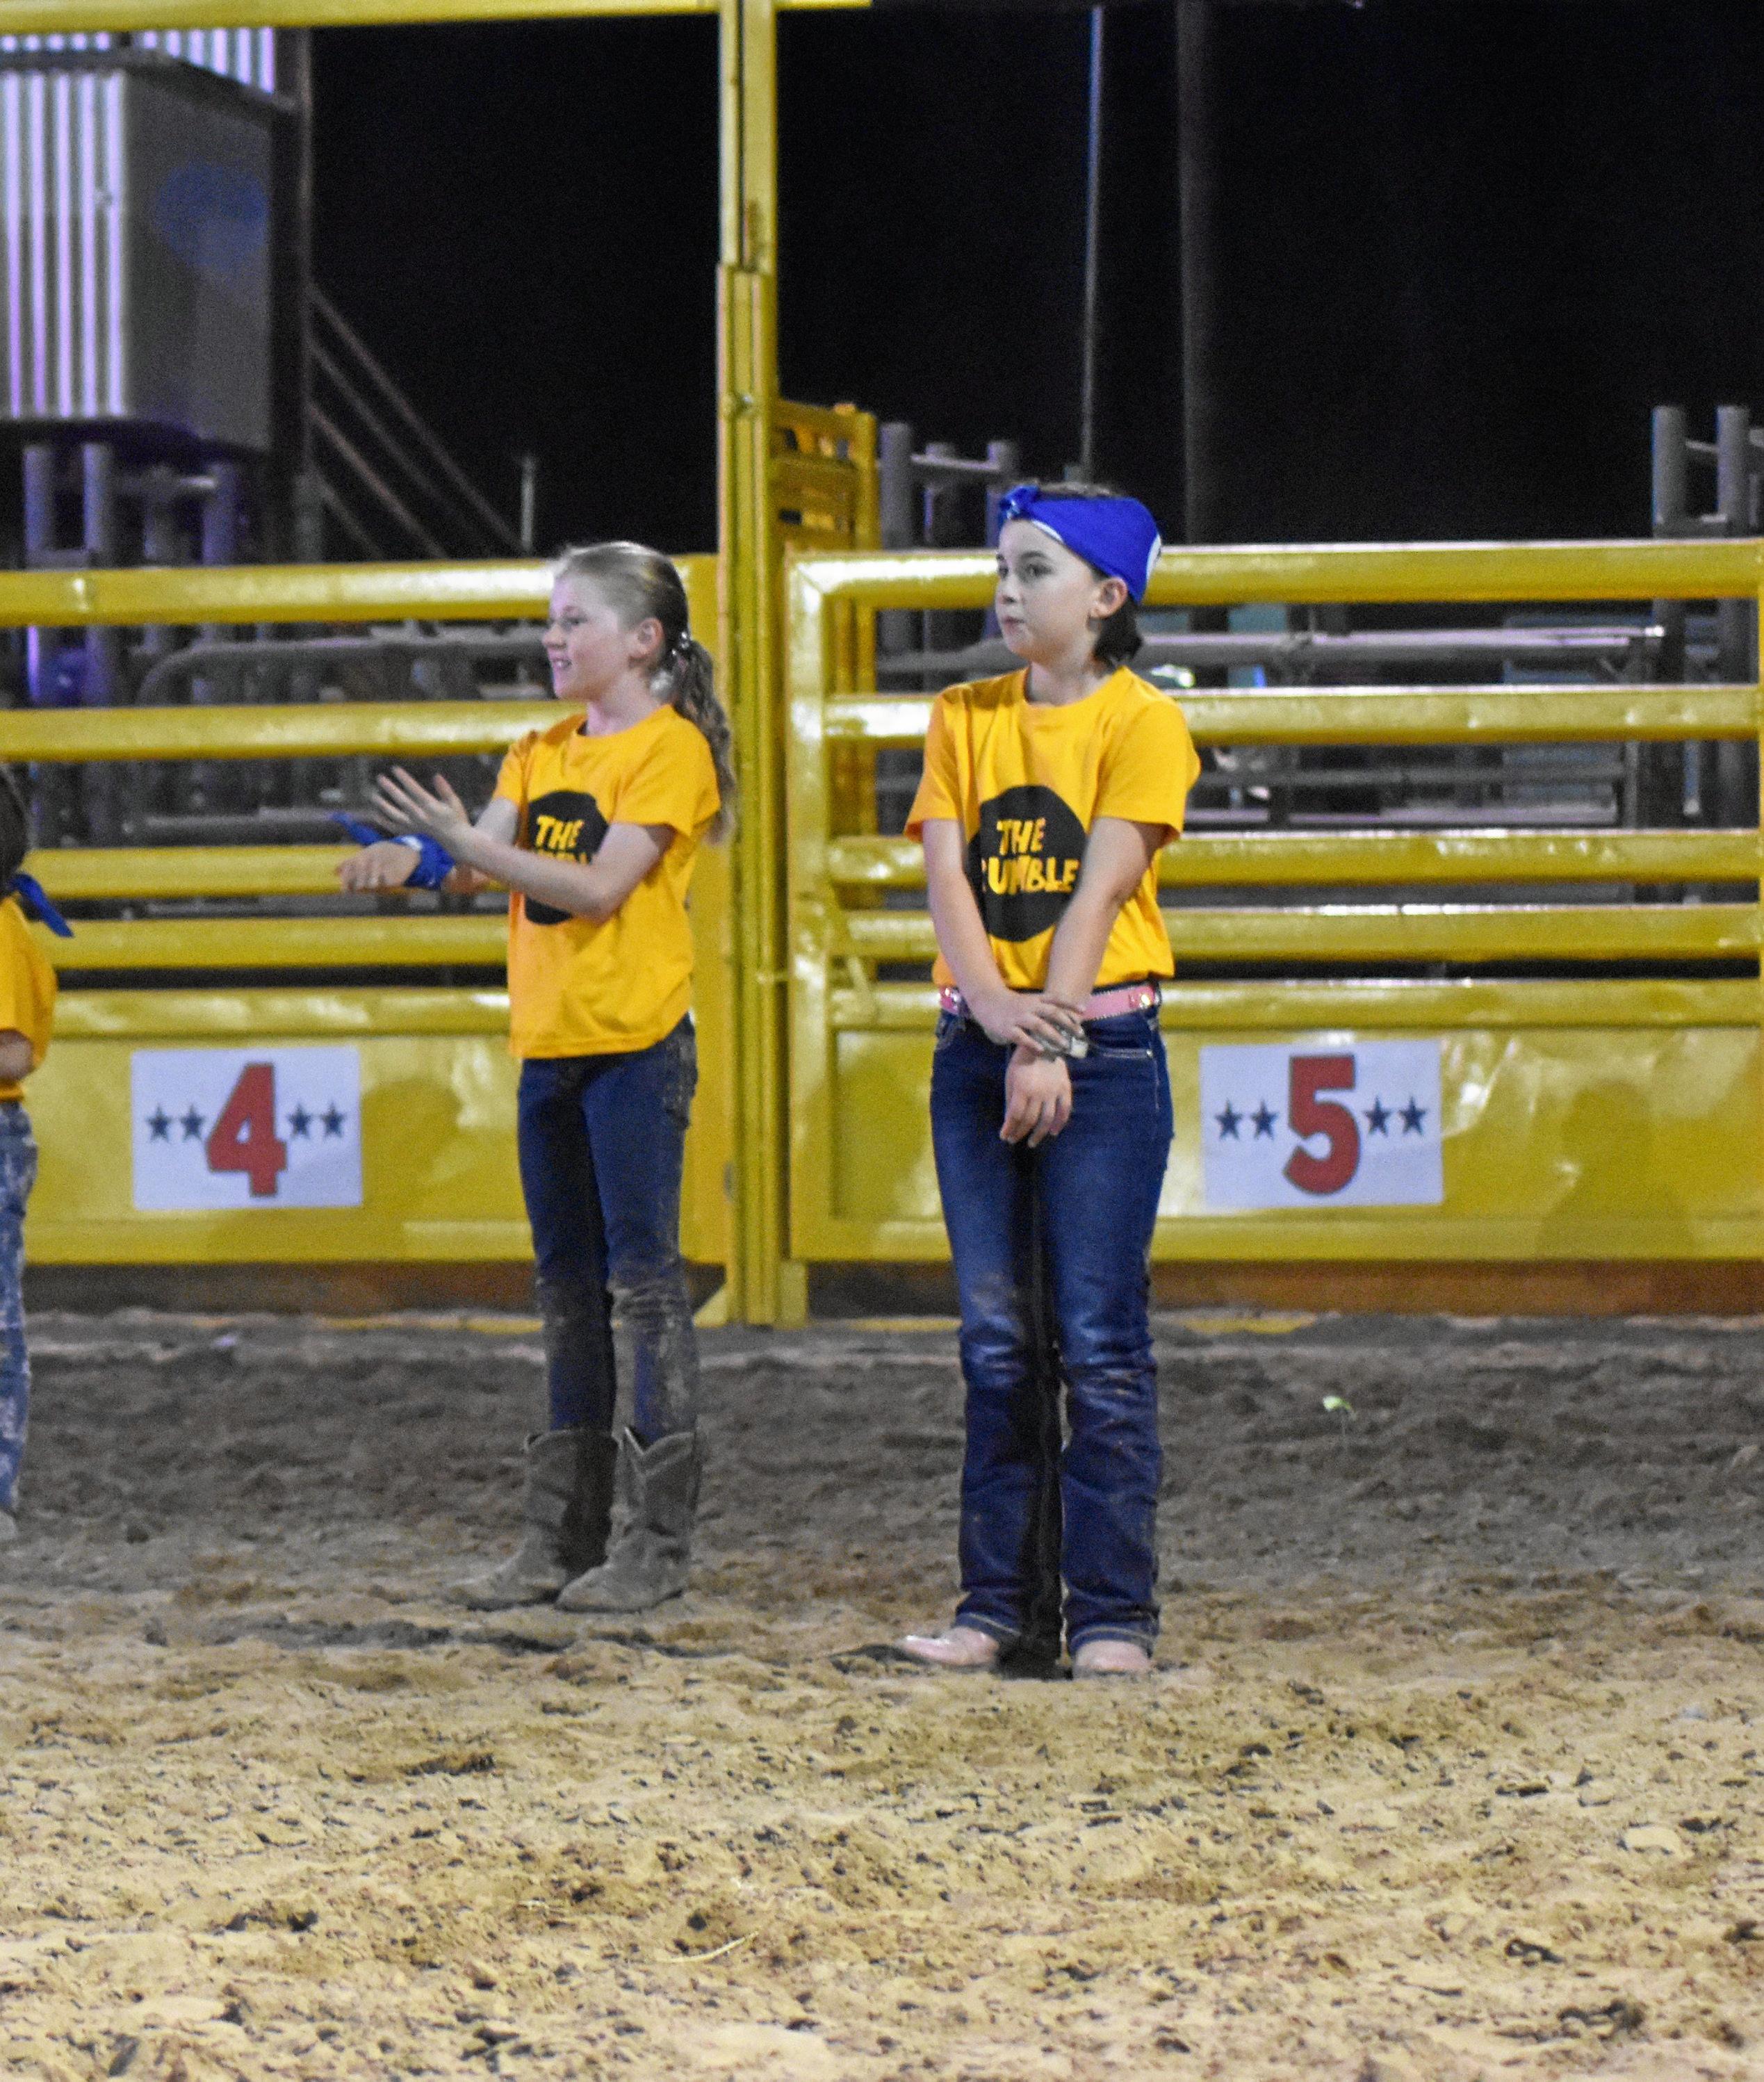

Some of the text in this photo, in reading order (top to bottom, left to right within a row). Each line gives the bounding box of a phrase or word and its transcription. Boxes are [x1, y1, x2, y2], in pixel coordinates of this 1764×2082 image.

[535, 815, 585, 850] THE
[997, 818, 1046, 855] THE
[206, 1062, 287, 1196] 4
[1283, 1054, 1360, 1195] 5
